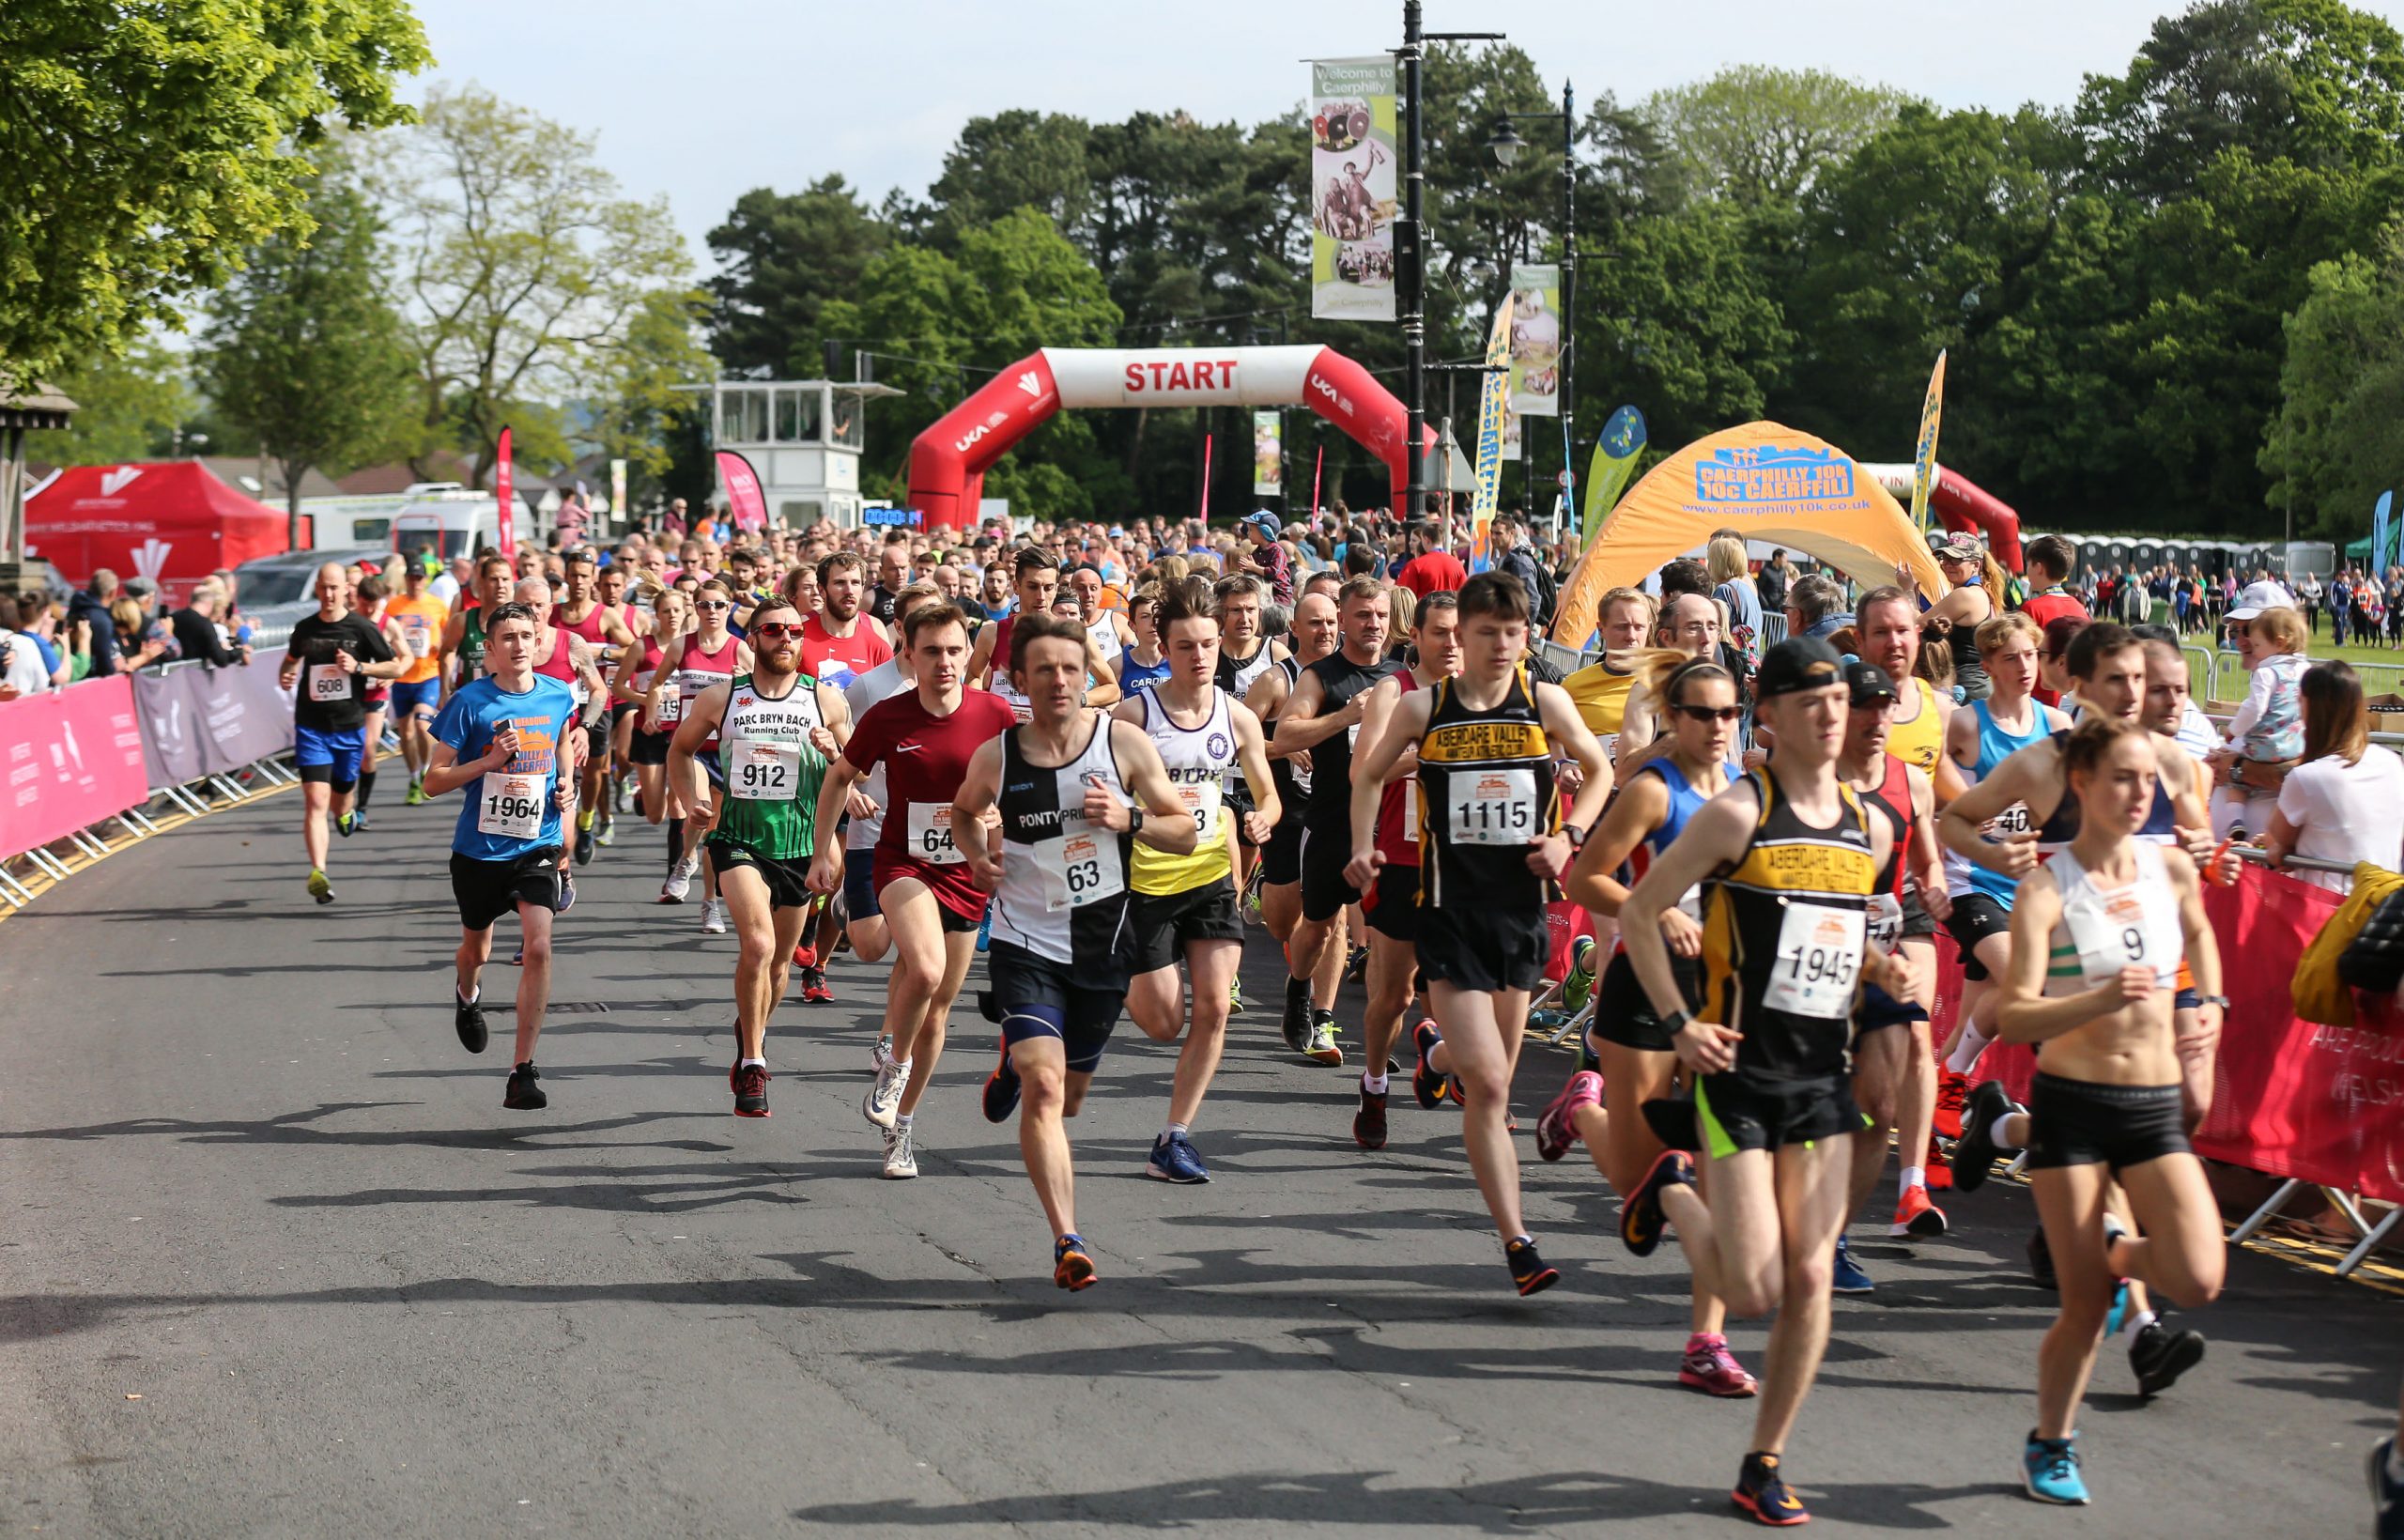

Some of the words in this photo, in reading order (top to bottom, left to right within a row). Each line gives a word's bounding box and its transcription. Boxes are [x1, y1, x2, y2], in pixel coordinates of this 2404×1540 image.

[1315, 67, 1377, 81] Welcome
[1379, 67, 1394, 79] to
[1321, 81, 1387, 96] Caerphilly
[1125, 361, 1238, 392] START
[1310, 373, 1338, 403] UKA
[955, 424, 991, 452] UKA
[1701, 466, 1810, 483] CAERPHILLY
[1701, 482, 1740, 500] 10c
[1745, 478, 1850, 500] CAERFFILI
[1682, 499, 1871, 516] www.caerphilly10k.co.uk
[316, 679, 344, 693] 608
[733, 714, 758, 729] PARC
[760, 714, 783, 724] BRYN
[786, 714, 811, 729] BACH
[744, 727, 778, 735] Running
[1436, 726, 1490, 747] ABERDARE
[1493, 726, 1532, 744] VALLEY
[743, 763, 786, 788] 912
[488, 794, 540, 820] 1964
[1457, 802, 1528, 828] 1115
[923, 828, 955, 853] 64
[1066, 860, 1101, 893] 63
[2122, 927, 2145, 962] 9
[1789, 945, 1856, 986] 1945
